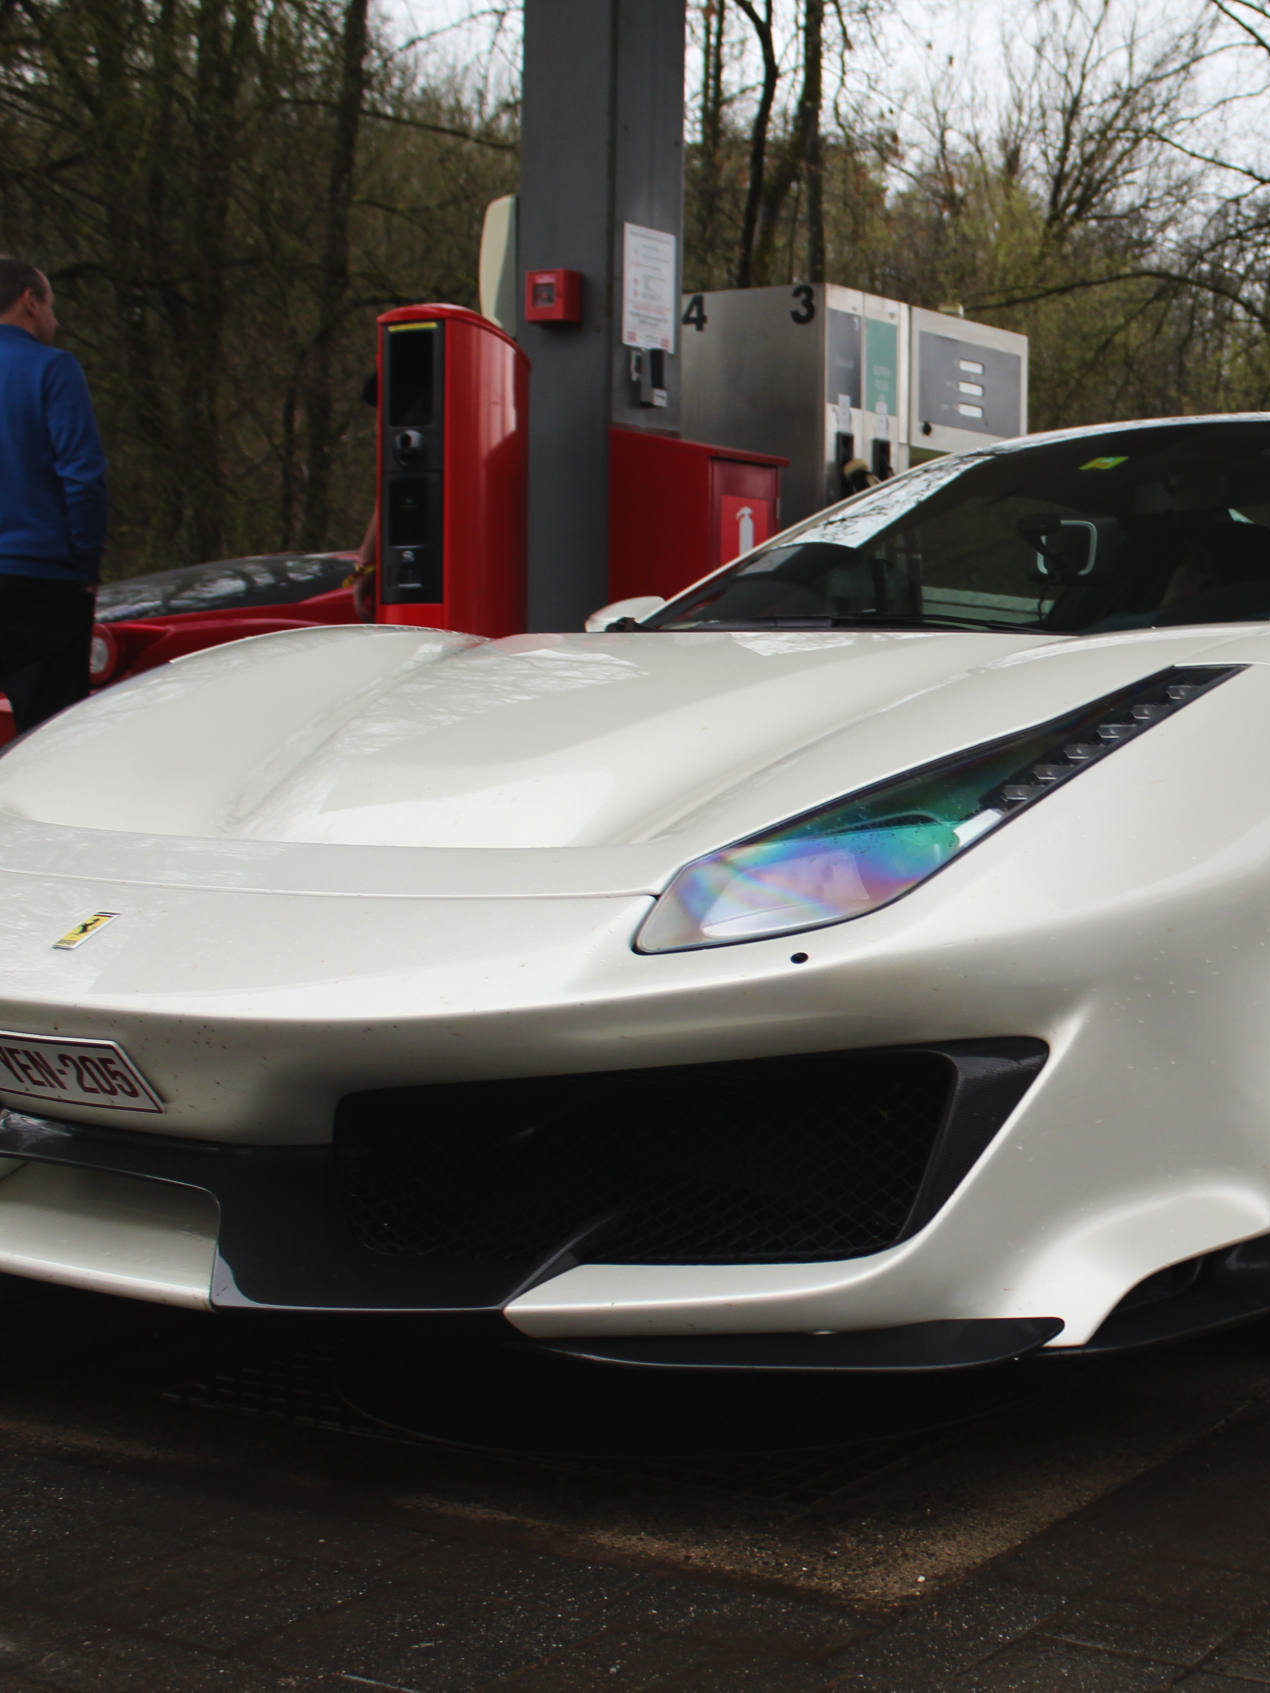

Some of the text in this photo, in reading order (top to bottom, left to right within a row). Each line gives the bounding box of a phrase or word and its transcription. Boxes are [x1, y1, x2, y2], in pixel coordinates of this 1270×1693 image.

[682, 295, 708, 332] 4
[790, 284, 816, 325] 3
[0, 1046, 140, 1098] YEN-205
